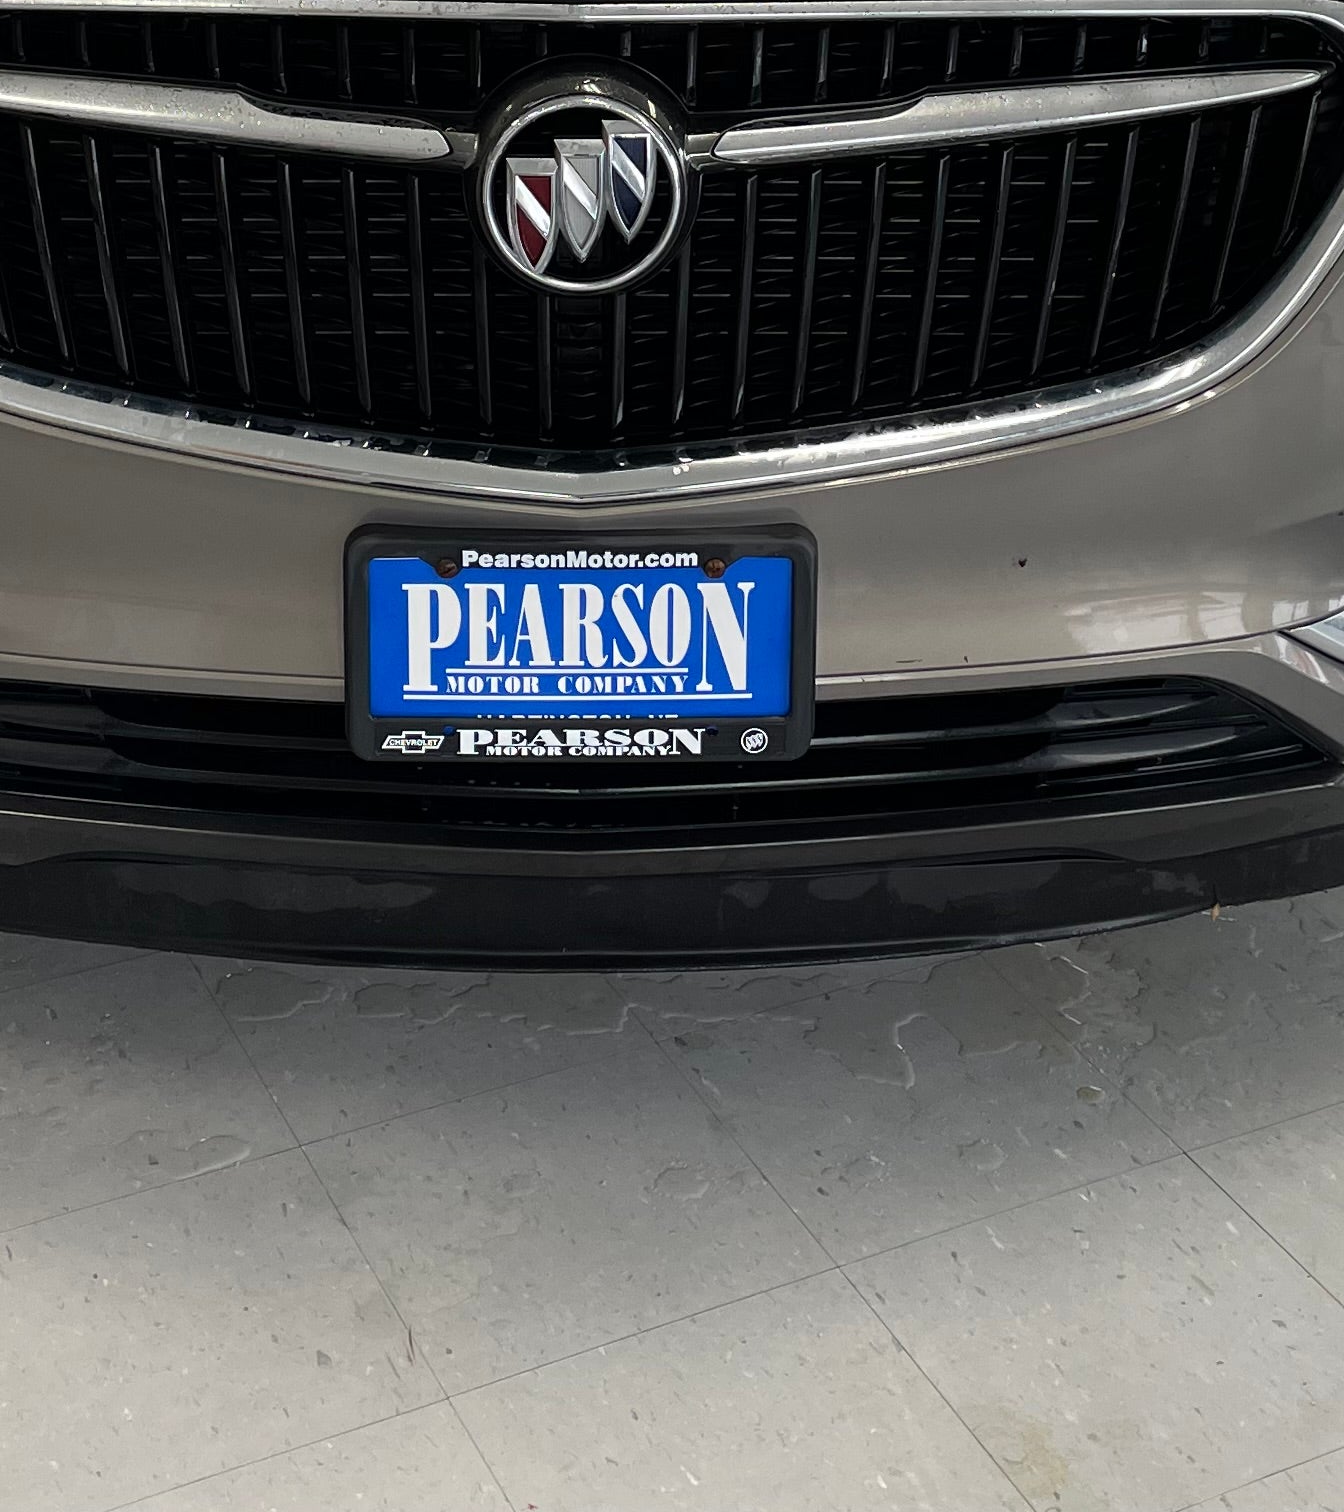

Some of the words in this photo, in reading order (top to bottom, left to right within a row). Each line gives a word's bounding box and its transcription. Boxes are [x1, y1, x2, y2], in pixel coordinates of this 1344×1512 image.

[461, 549, 699, 569] PearsonMotor.com
[401, 581, 756, 692] PEARSON
[446, 675, 540, 694] MOTOR
[557, 674, 689, 695] COMPANY
[456, 727, 706, 756] PEARSON
[485, 744, 563, 757] MOTOR
[567, 744, 672, 757] COMPANY
